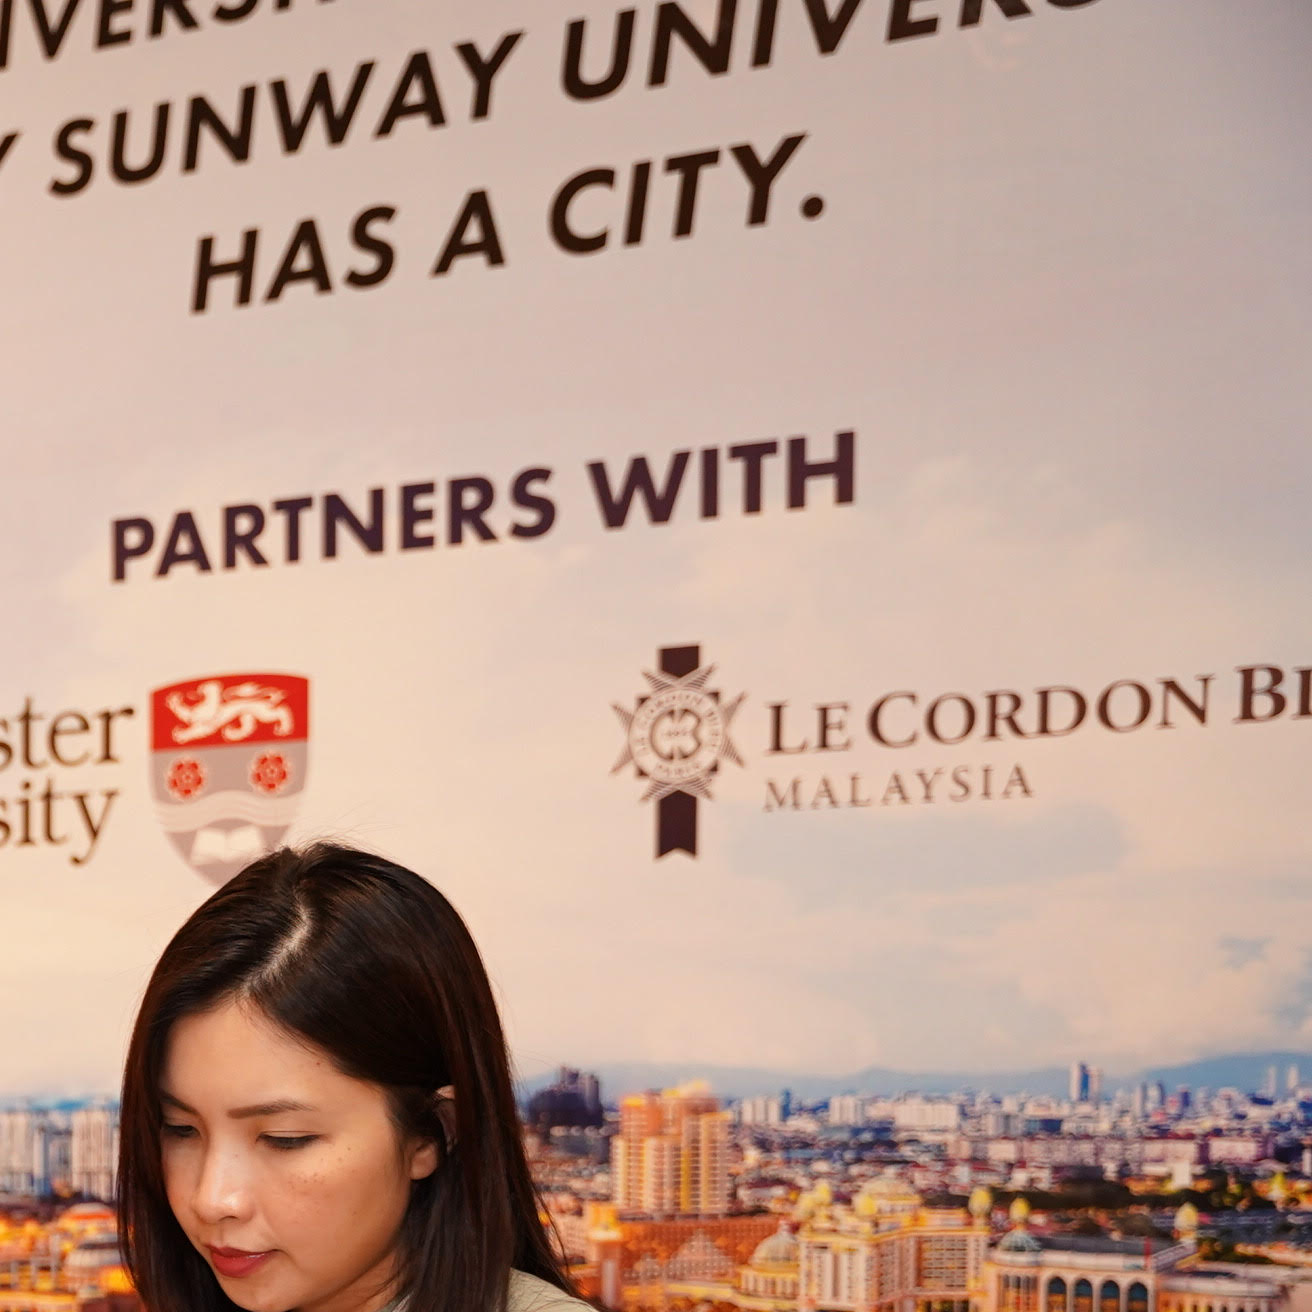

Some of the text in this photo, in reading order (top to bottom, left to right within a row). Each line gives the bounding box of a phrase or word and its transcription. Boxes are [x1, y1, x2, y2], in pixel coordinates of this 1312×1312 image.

[48, 29, 525, 199] SUNWAY
[561, 0, 1101, 102] UNIV
[191, 132, 825, 315] HAS A CITY.
[110, 428, 858, 584] PARTNERS WITH
[763, 699, 852, 757] LE
[868, 672, 1214, 751] CORDON
[763, 763, 1034, 814] MALAYSIA
